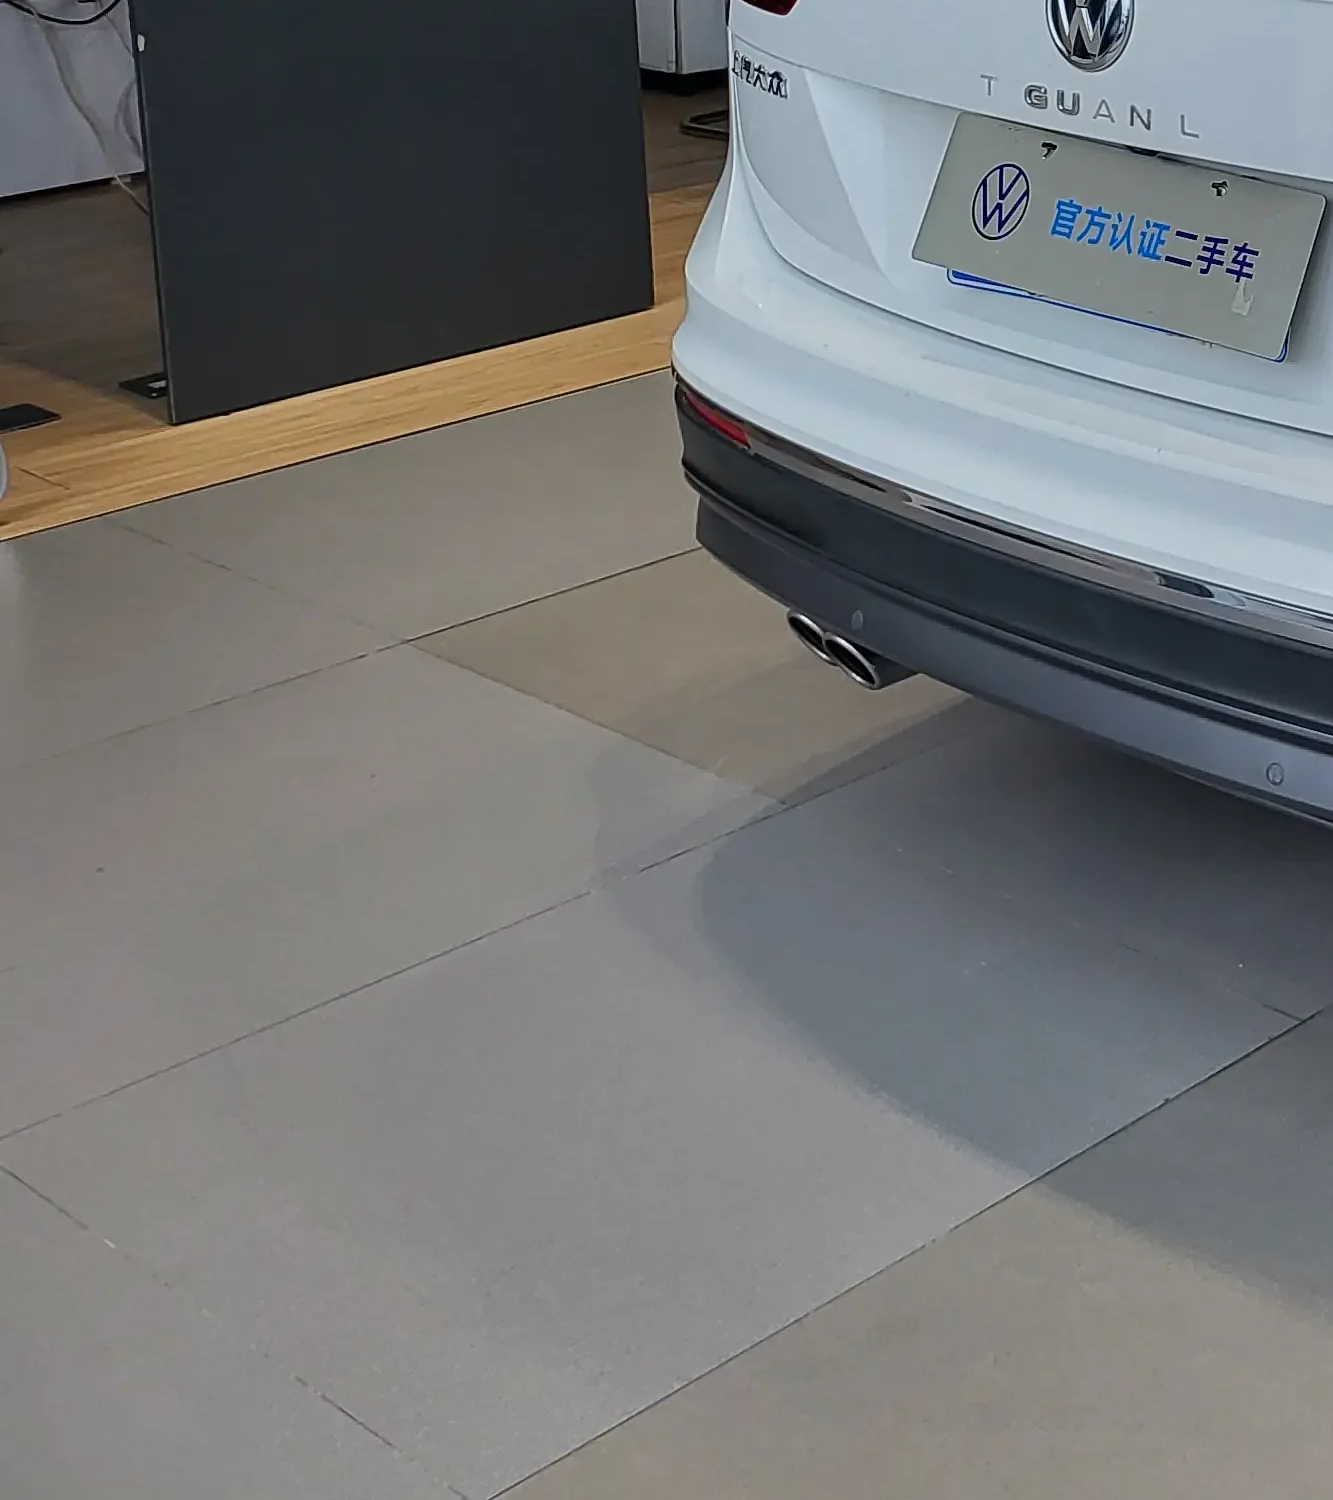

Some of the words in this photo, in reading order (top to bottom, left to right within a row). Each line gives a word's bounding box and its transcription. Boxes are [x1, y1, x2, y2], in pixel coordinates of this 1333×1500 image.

[1048, 197, 1261, 284] 官方认证二手车
